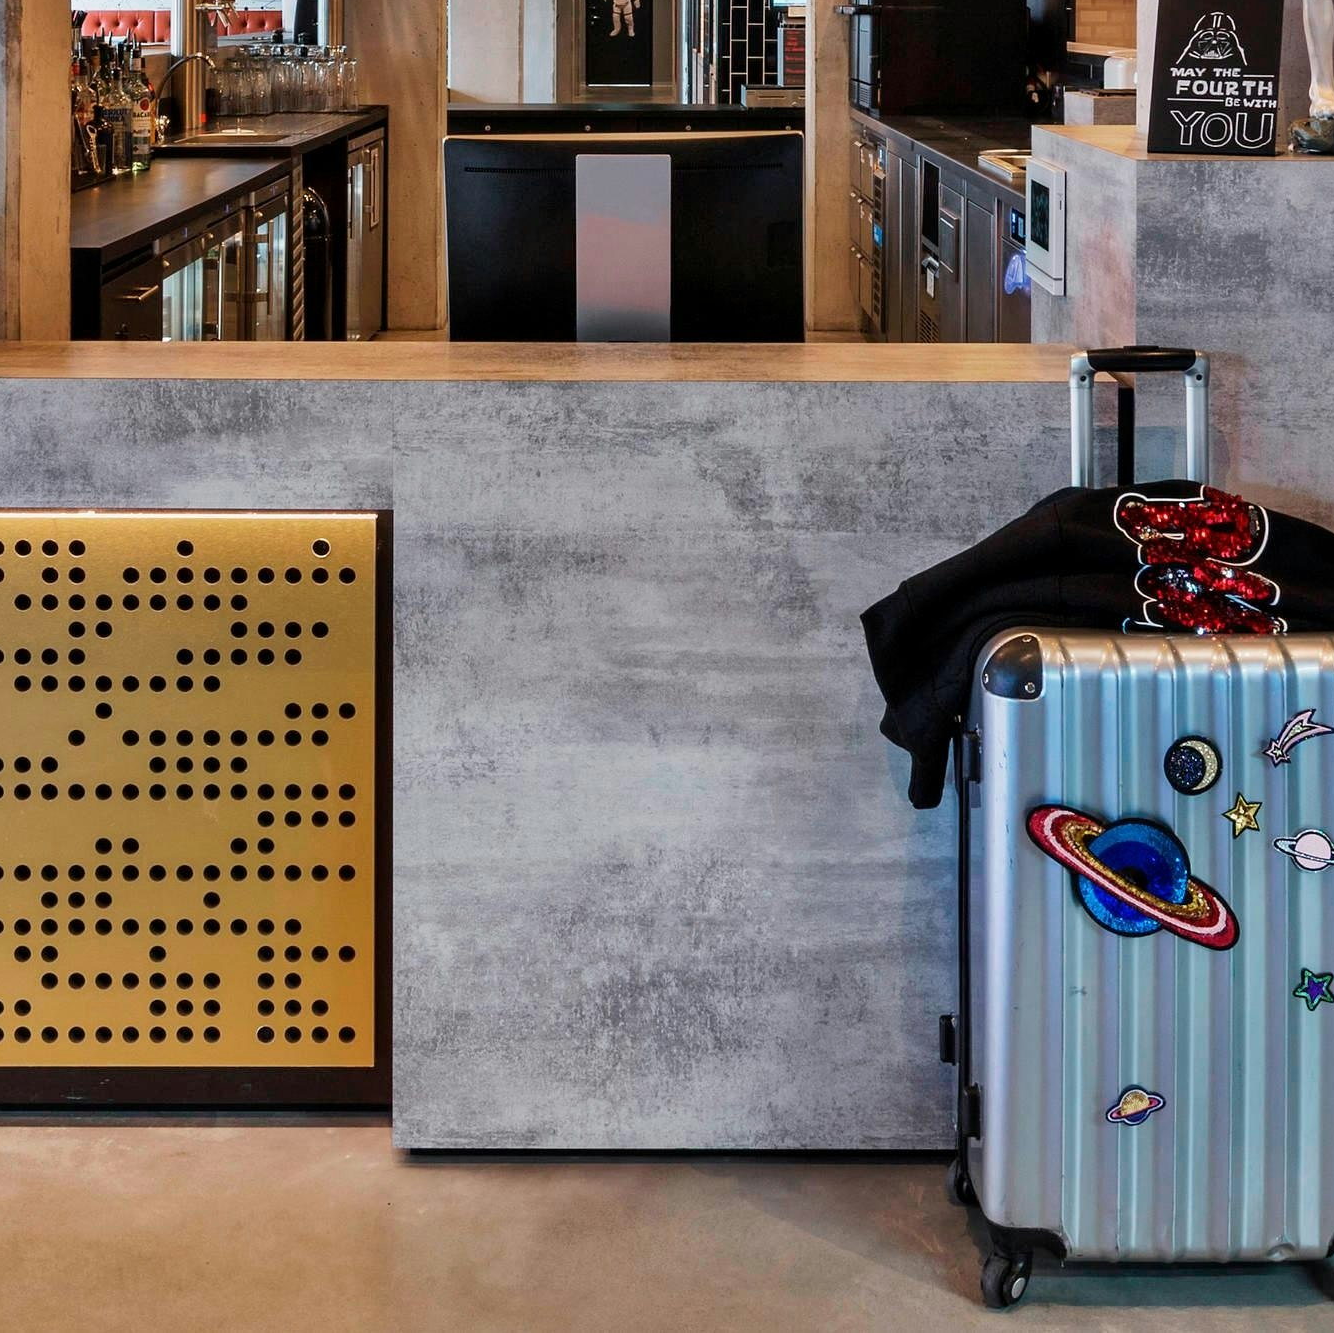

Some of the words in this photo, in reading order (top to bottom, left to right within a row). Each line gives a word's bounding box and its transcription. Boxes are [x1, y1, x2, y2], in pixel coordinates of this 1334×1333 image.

[1170, 67, 1207, 77] MAY
[1213, 67, 1241, 78] THE
[1176, 79, 1273, 96] FOURTH
[1225, 97, 1241, 107] BE
[1243, 98, 1277, 108] WITH
[1170, 110, 1275, 150] YOU
